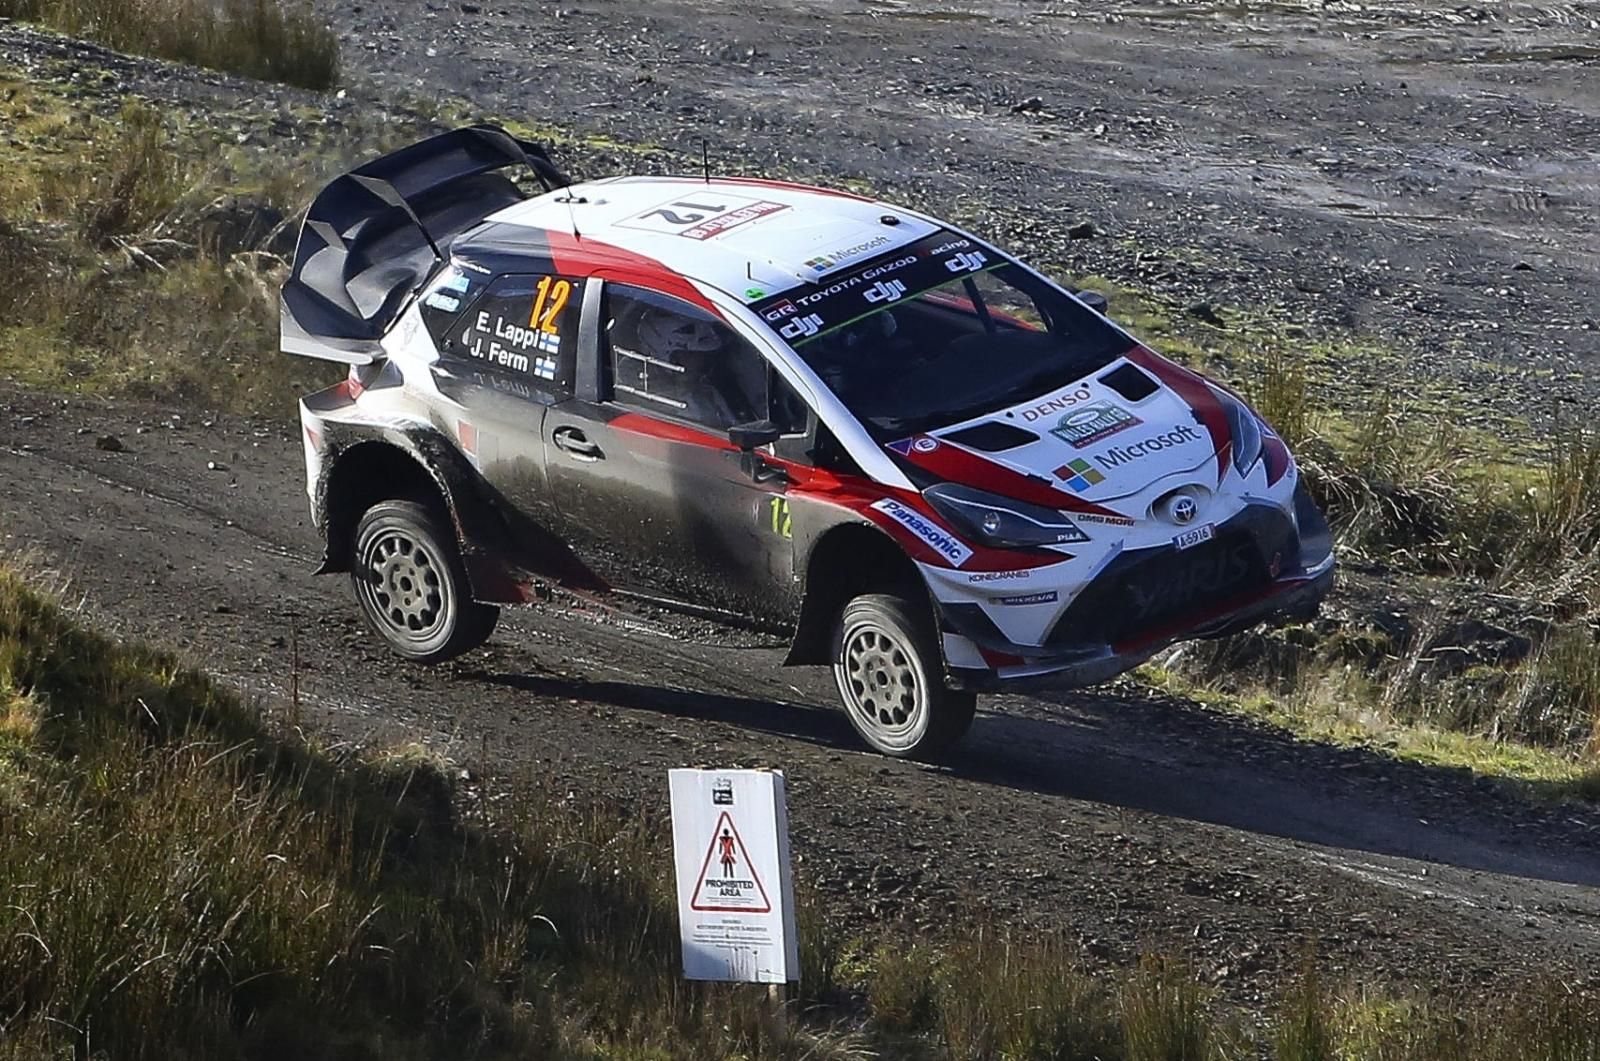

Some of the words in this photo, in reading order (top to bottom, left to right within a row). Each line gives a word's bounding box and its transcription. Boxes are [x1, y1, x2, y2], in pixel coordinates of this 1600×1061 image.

[828, 236, 891, 261] Microsoft
[796, 276, 861, 307] TOYOTA
[862, 255, 918, 280] GAZOO
[921, 239, 970, 257] acing
[529, 275, 571, 334] 12
[766, 304, 795, 320] GR
[475, 311, 491, 333] E.
[496, 317, 540, 349] Lappi
[470, 338, 484, 358] J.
[489, 342, 528, 372] Ferm
[1022, 389, 1091, 422] DENSO
[1094, 425, 1202, 470] Microsoft
[882, 502, 962, 559] Panasonic
[1057, 532, 1083, 541] PIAA
[1078, 514, 1104, 523] DMG
[1105, 517, 1135, 527] MORI
[705, 879, 754, 889] PROHIBITED
[720, 887, 741, 896] AREA
